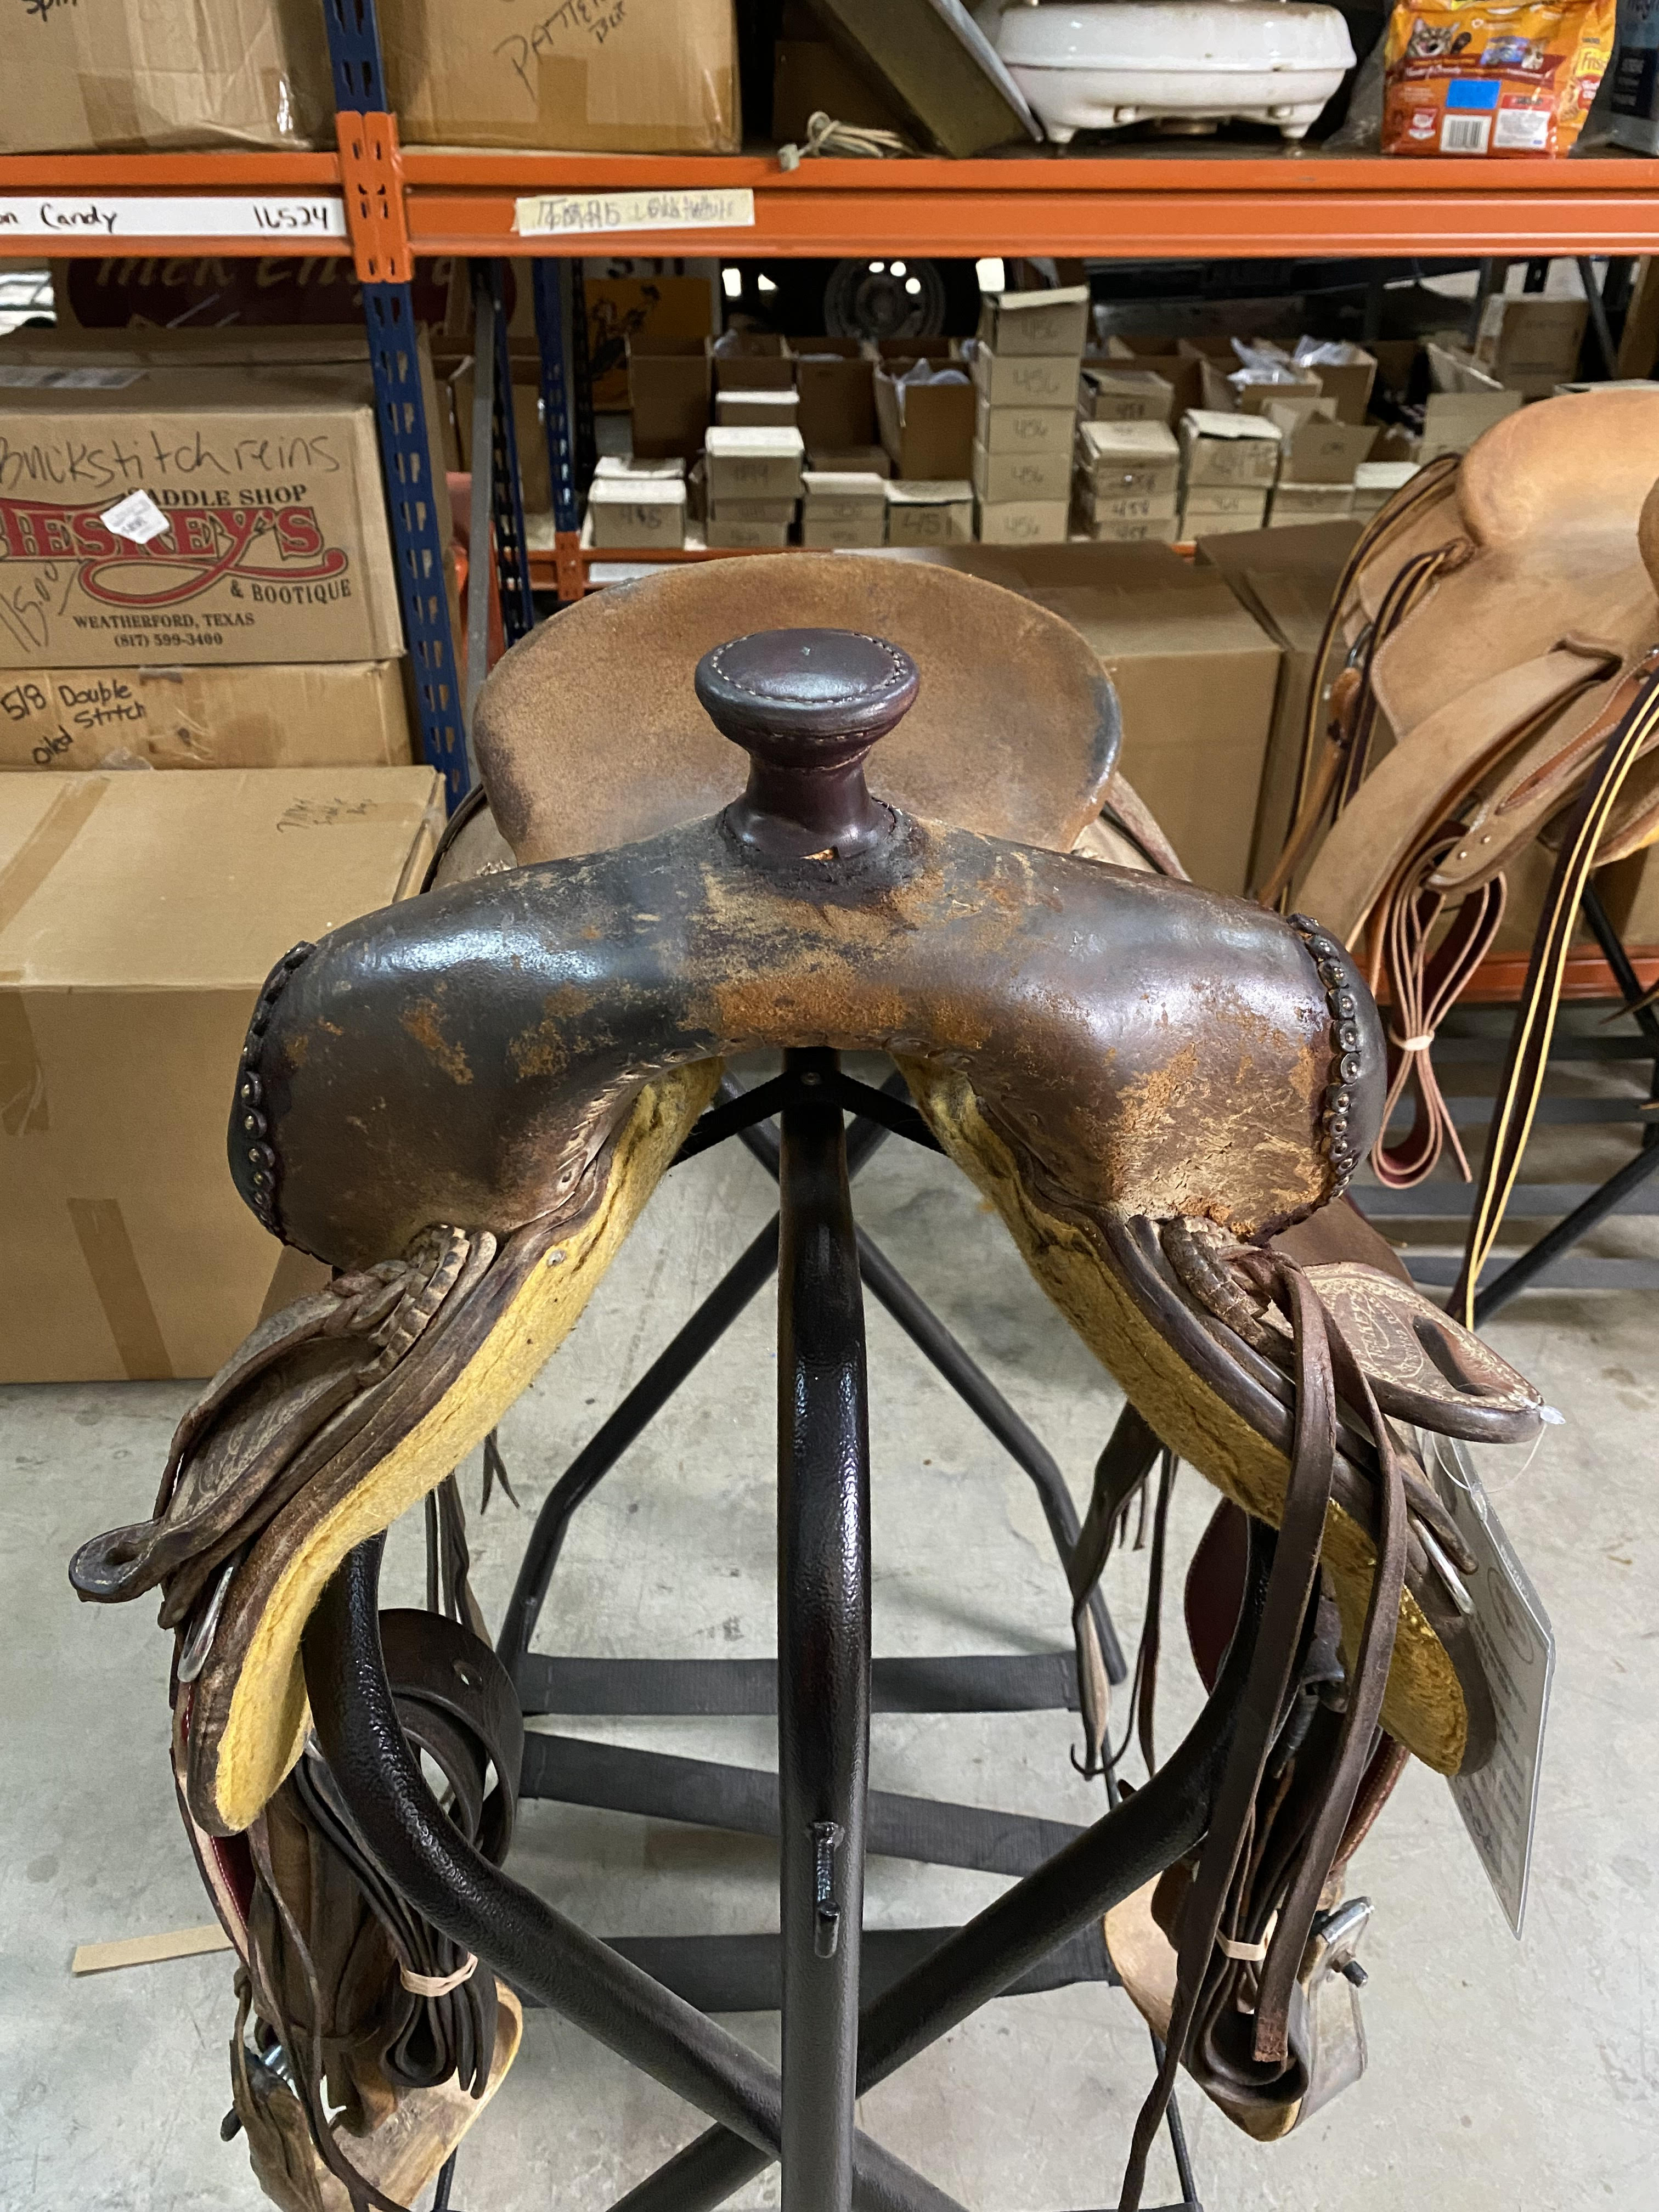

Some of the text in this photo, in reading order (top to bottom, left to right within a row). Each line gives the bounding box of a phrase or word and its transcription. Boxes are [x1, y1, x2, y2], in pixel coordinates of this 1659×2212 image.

[40, 203, 117, 233] Candy
[253, 205, 328, 228] 16524
[128, 484, 307, 507] ADDLE SHOP
[230, 579, 352, 604] & BOOTIQUE
[72, 612, 255, 629] WEATHERFORD, TEXAS
[114, 631, 223, 648] (817) 599-3400
[0, 679, 132, 721] 5/8 Double
